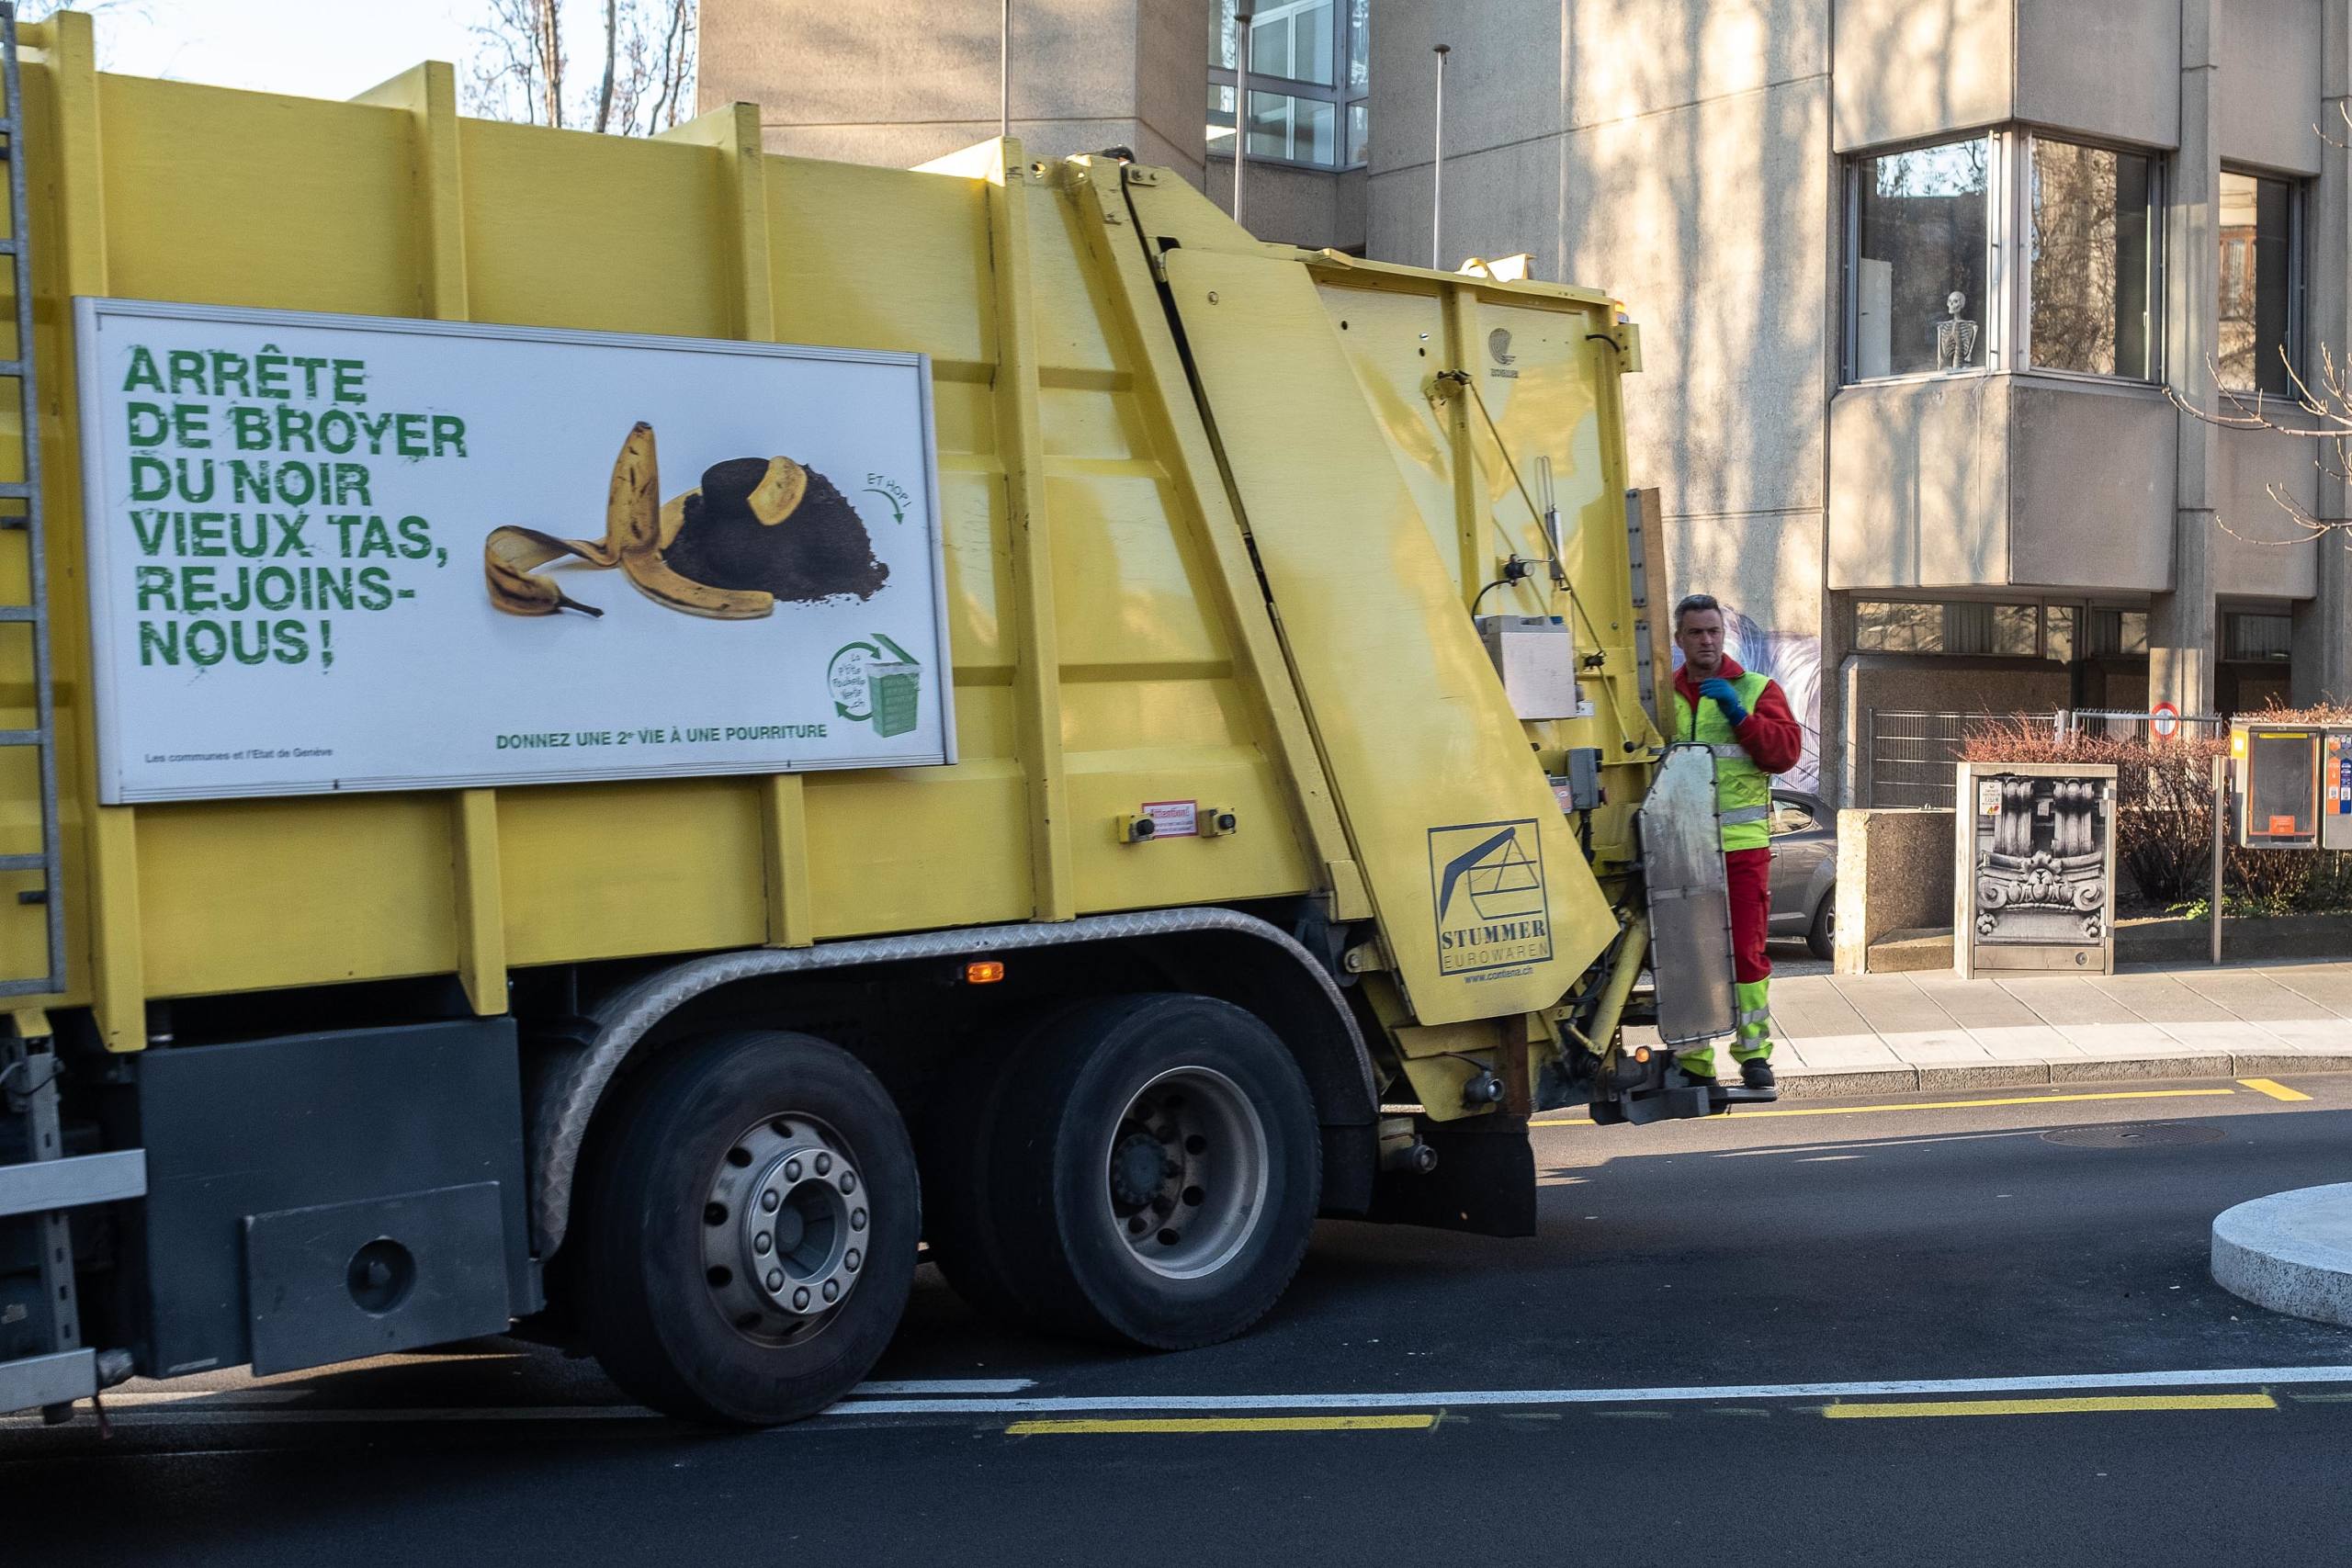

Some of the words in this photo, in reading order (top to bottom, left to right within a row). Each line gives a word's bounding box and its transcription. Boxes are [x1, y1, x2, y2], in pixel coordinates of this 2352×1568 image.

[122, 344, 367, 402] ARRÊTE
[128, 401, 212, 449] DE
[233, 406, 469, 457] BROYER
[130, 456, 214, 503] DU
[230, 458, 372, 506] NOIR
[130, 512, 314, 558] VIEUX
[327, 514, 447, 568] TAS,
[136, 565, 415, 613] REJOINS-
[144, 753, 166, 763] Les
[167, 752, 231, 762] communes
[232, 750, 245, 761] et
[276, 749, 291, 759] de
[292, 747, 334, 758] Genève
[496, 732, 571, 750] DONNEZ
[575, 731, 612, 747] UNE
[638, 728, 665, 744] VIE
[686, 728, 720, 742] UNE
[725, 724, 828, 741] POURRITURE
[1442, 919, 1545, 950] STUMMER
[1443, 942, 1548, 969] EUROWAREN
